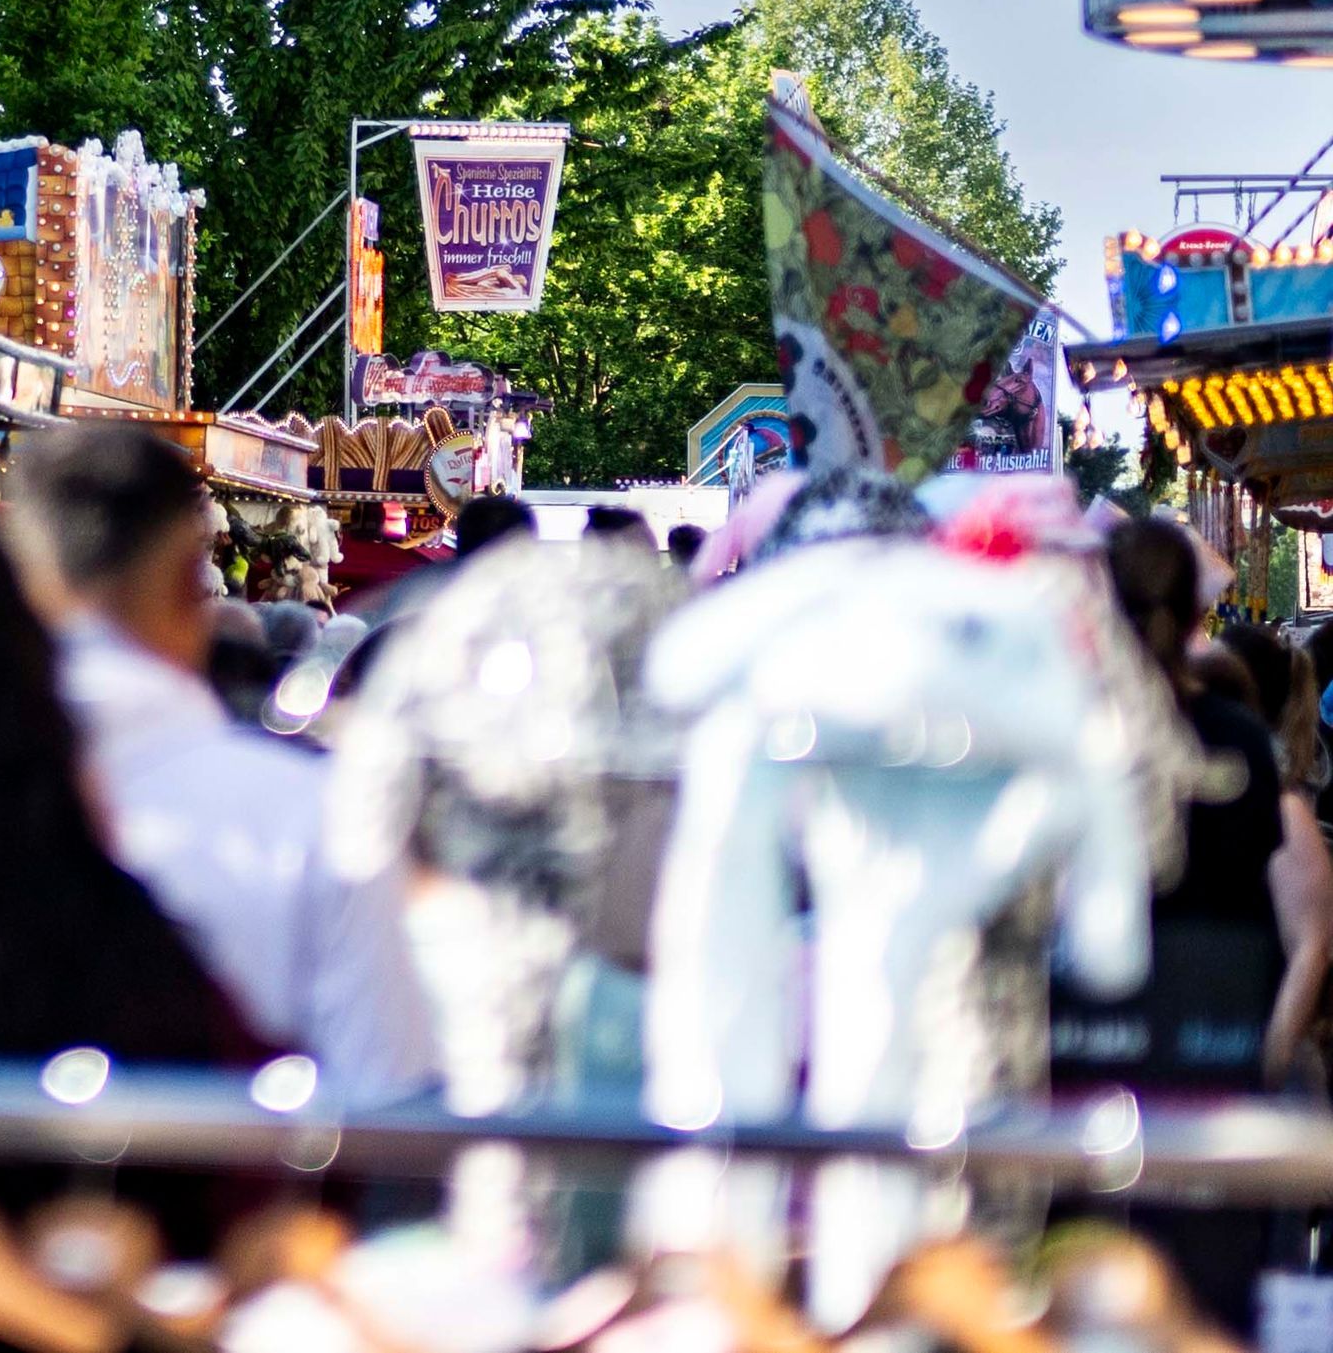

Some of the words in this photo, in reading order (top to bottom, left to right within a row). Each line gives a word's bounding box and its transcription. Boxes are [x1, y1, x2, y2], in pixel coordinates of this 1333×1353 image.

[456, 162, 496, 185] Spanische
[472, 182, 536, 199] Heiße
[434, 173, 542, 246] Churros
[443, 250, 484, 264] immer
[487, 247, 532, 269] frisch!!!
[993, 449, 1049, 473] Auswahl!
